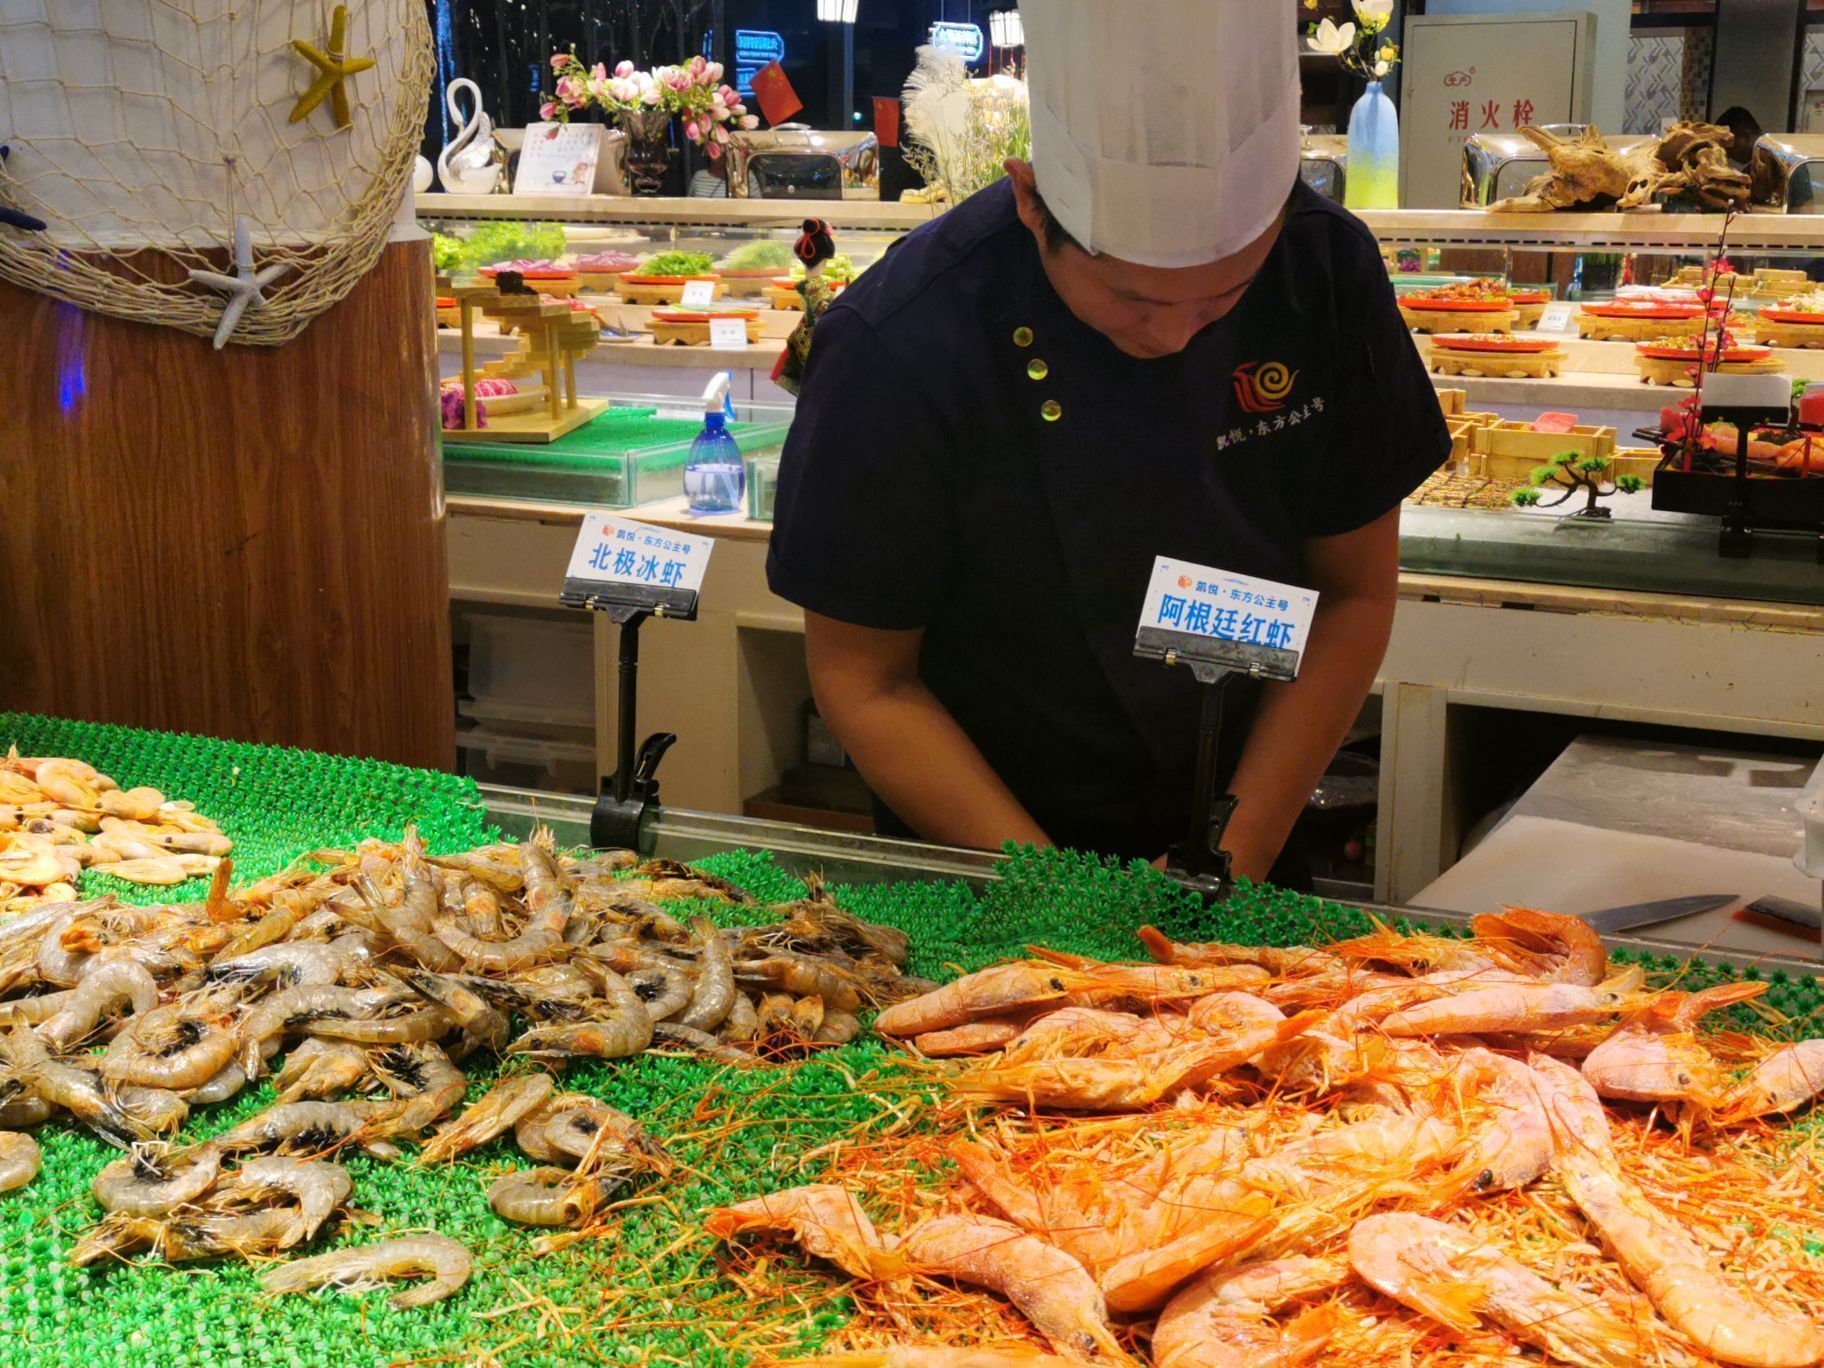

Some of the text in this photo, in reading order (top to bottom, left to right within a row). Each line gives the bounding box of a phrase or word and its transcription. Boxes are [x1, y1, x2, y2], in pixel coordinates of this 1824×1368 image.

[1449, 99, 1534, 130] 消火栓
[588, 542, 687, 588] 北极冰虾
[1157, 593, 1296, 650] 阿根廷红虾
